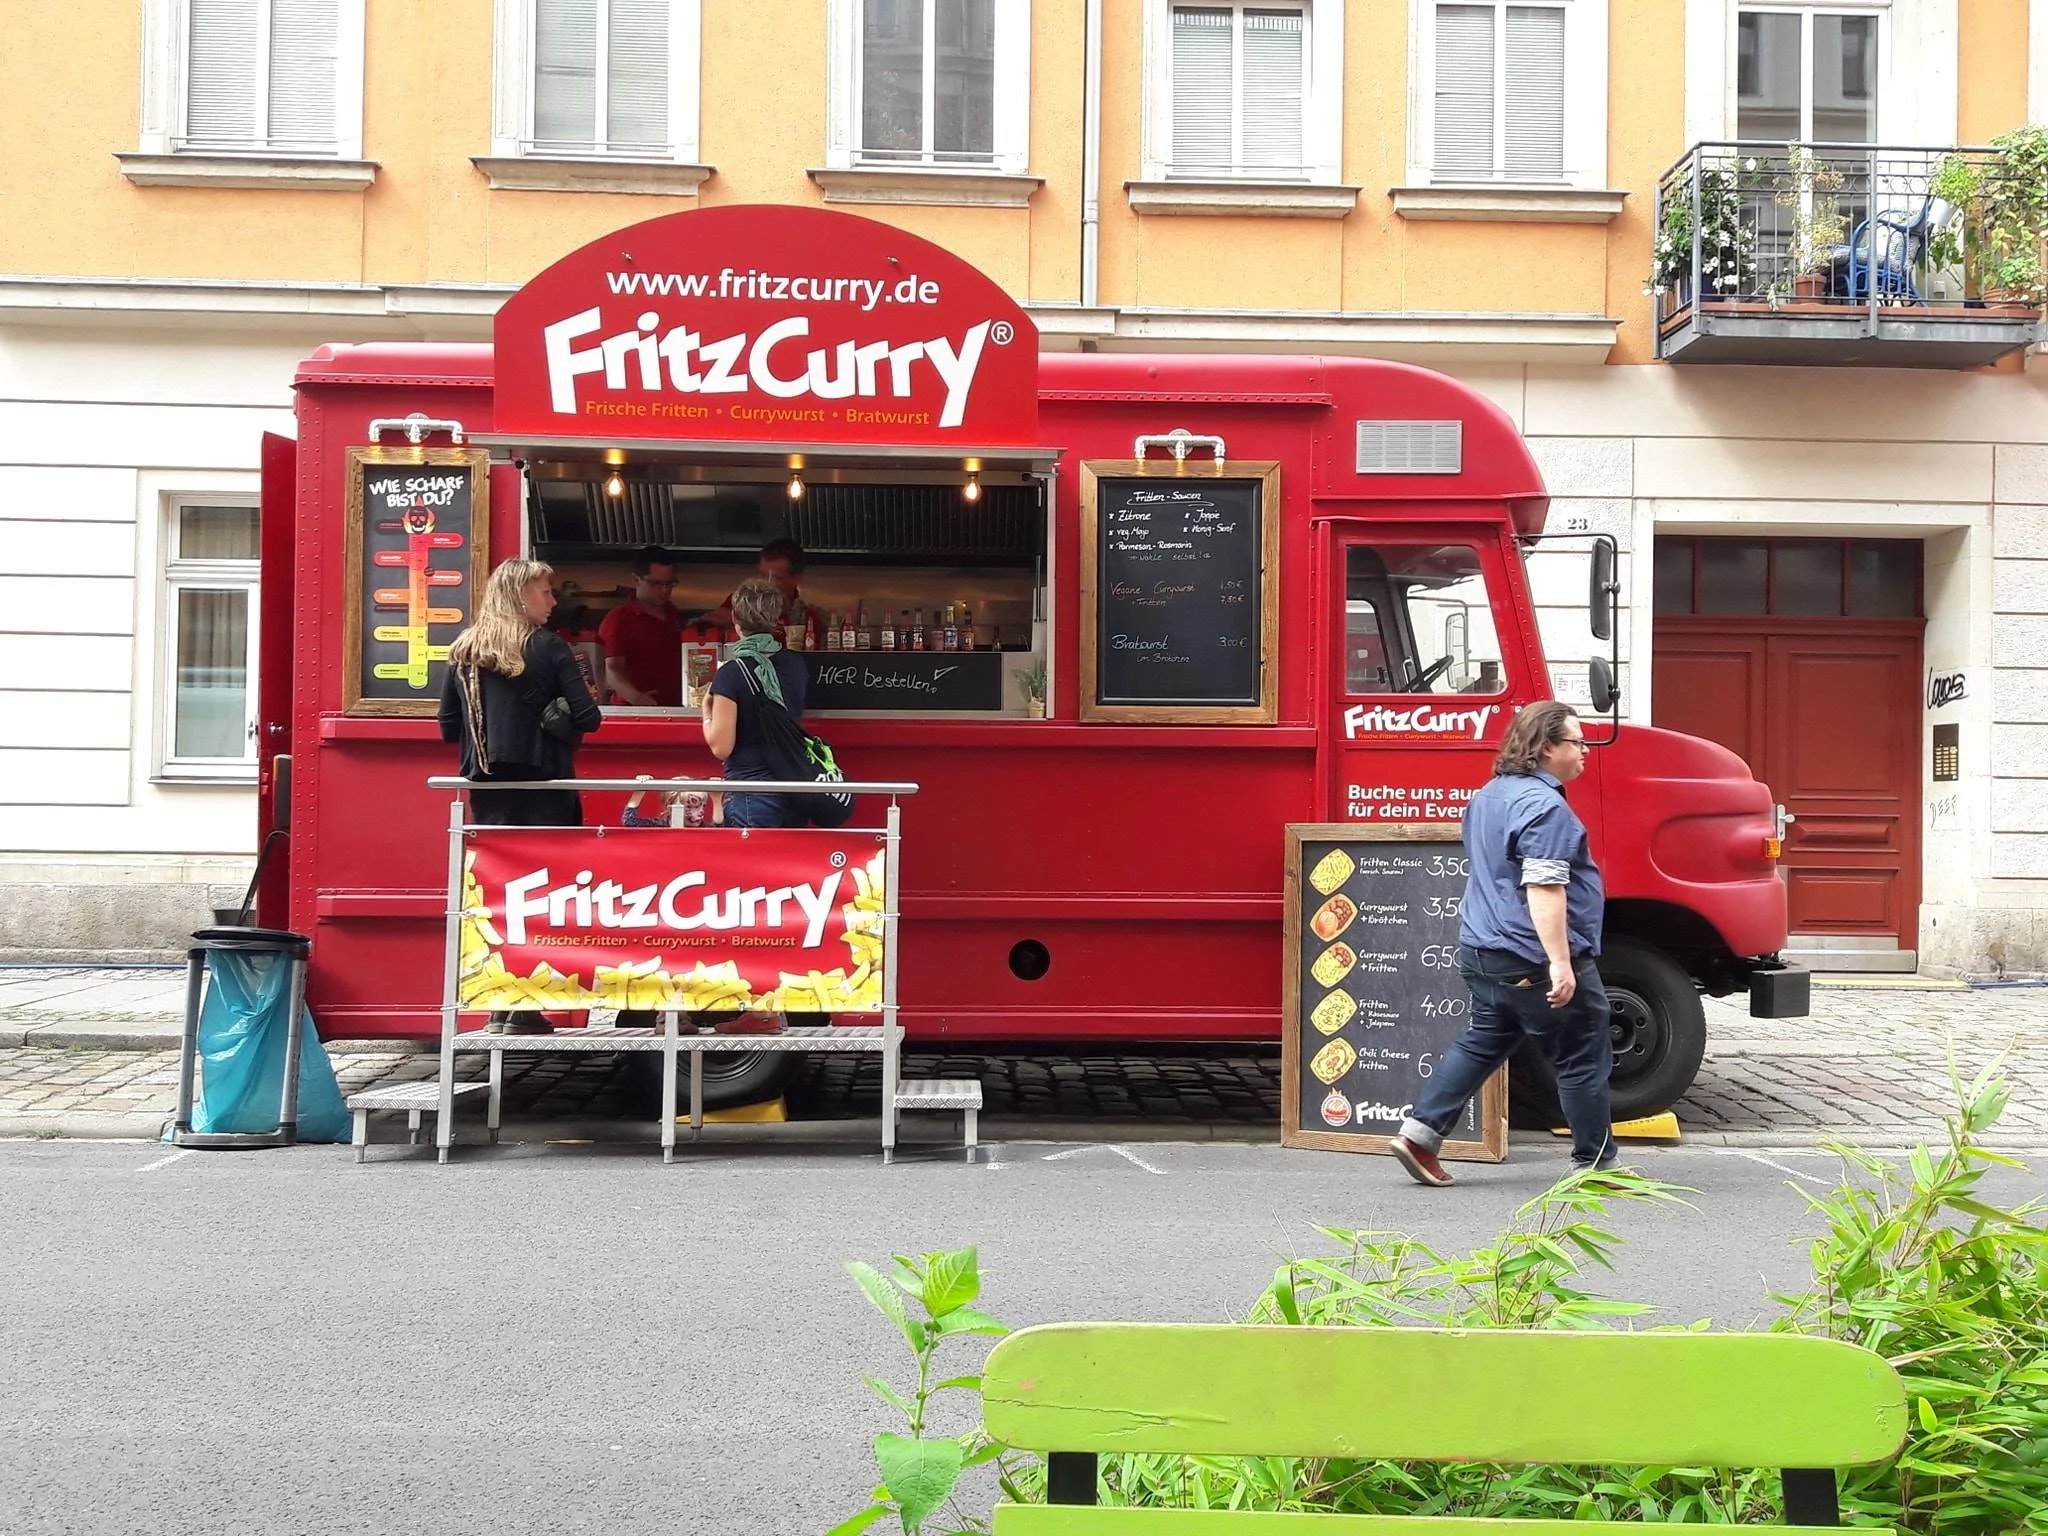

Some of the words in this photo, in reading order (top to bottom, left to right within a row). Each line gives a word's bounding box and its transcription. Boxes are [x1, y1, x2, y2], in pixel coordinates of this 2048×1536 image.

[606, 268, 940, 312] www.fritzcurry.de
[585, 400, 647, 417] Frische
[651, 401, 709, 418] Fritten
[730, 404, 825, 424] Currywurst
[846, 408, 930, 425] Bratwurst
[369, 478, 401, 495] WIE
[405, 475, 465, 492] SCHARF
[386, 492, 418, 508] BIST
[422, 488, 454, 506] DU?
[1118, 509, 1152, 522] Zitrone
[1192, 507, 1221, 523] Joppie
[1568, 518, 1589, 530] 23
[1110, 581, 1142, 600] Vegane
[1111, 634, 1169, 650] Bratwurst
[816, 665, 857, 685] HIER
[1348, 784, 1406, 801] Buche
[1410, 787, 1444, 801] uns
[1448, 787, 1478, 801] auc
[1348, 802, 1375, 818] für
[1379, 802, 1420, 818] dein
[1360, 857, 1389, 867] Fritten
[1393, 857, 1423, 867] Classic
[1359, 902, 1408, 914] Currywurst
[1422, 897, 1461, 920] 3,5
[533, 935, 581, 946] Frische
[583, 935, 627, 946] Fritten
[643, 935, 717, 950] Currywurst
[731, 936, 797, 947] Bratwurst
[1359, 949, 1408, 962] Currywurst
[1359, 999, 1389, 1009] Fritten
[1420, 994, 1466, 1018] 4,00
[1358, 1047, 1377, 1058] Chili
[1380, 1047, 1411, 1060] Cheese
[1358, 1060, 1389, 1071] Fritten
[1355, 1101, 1414, 1124] FritzC
